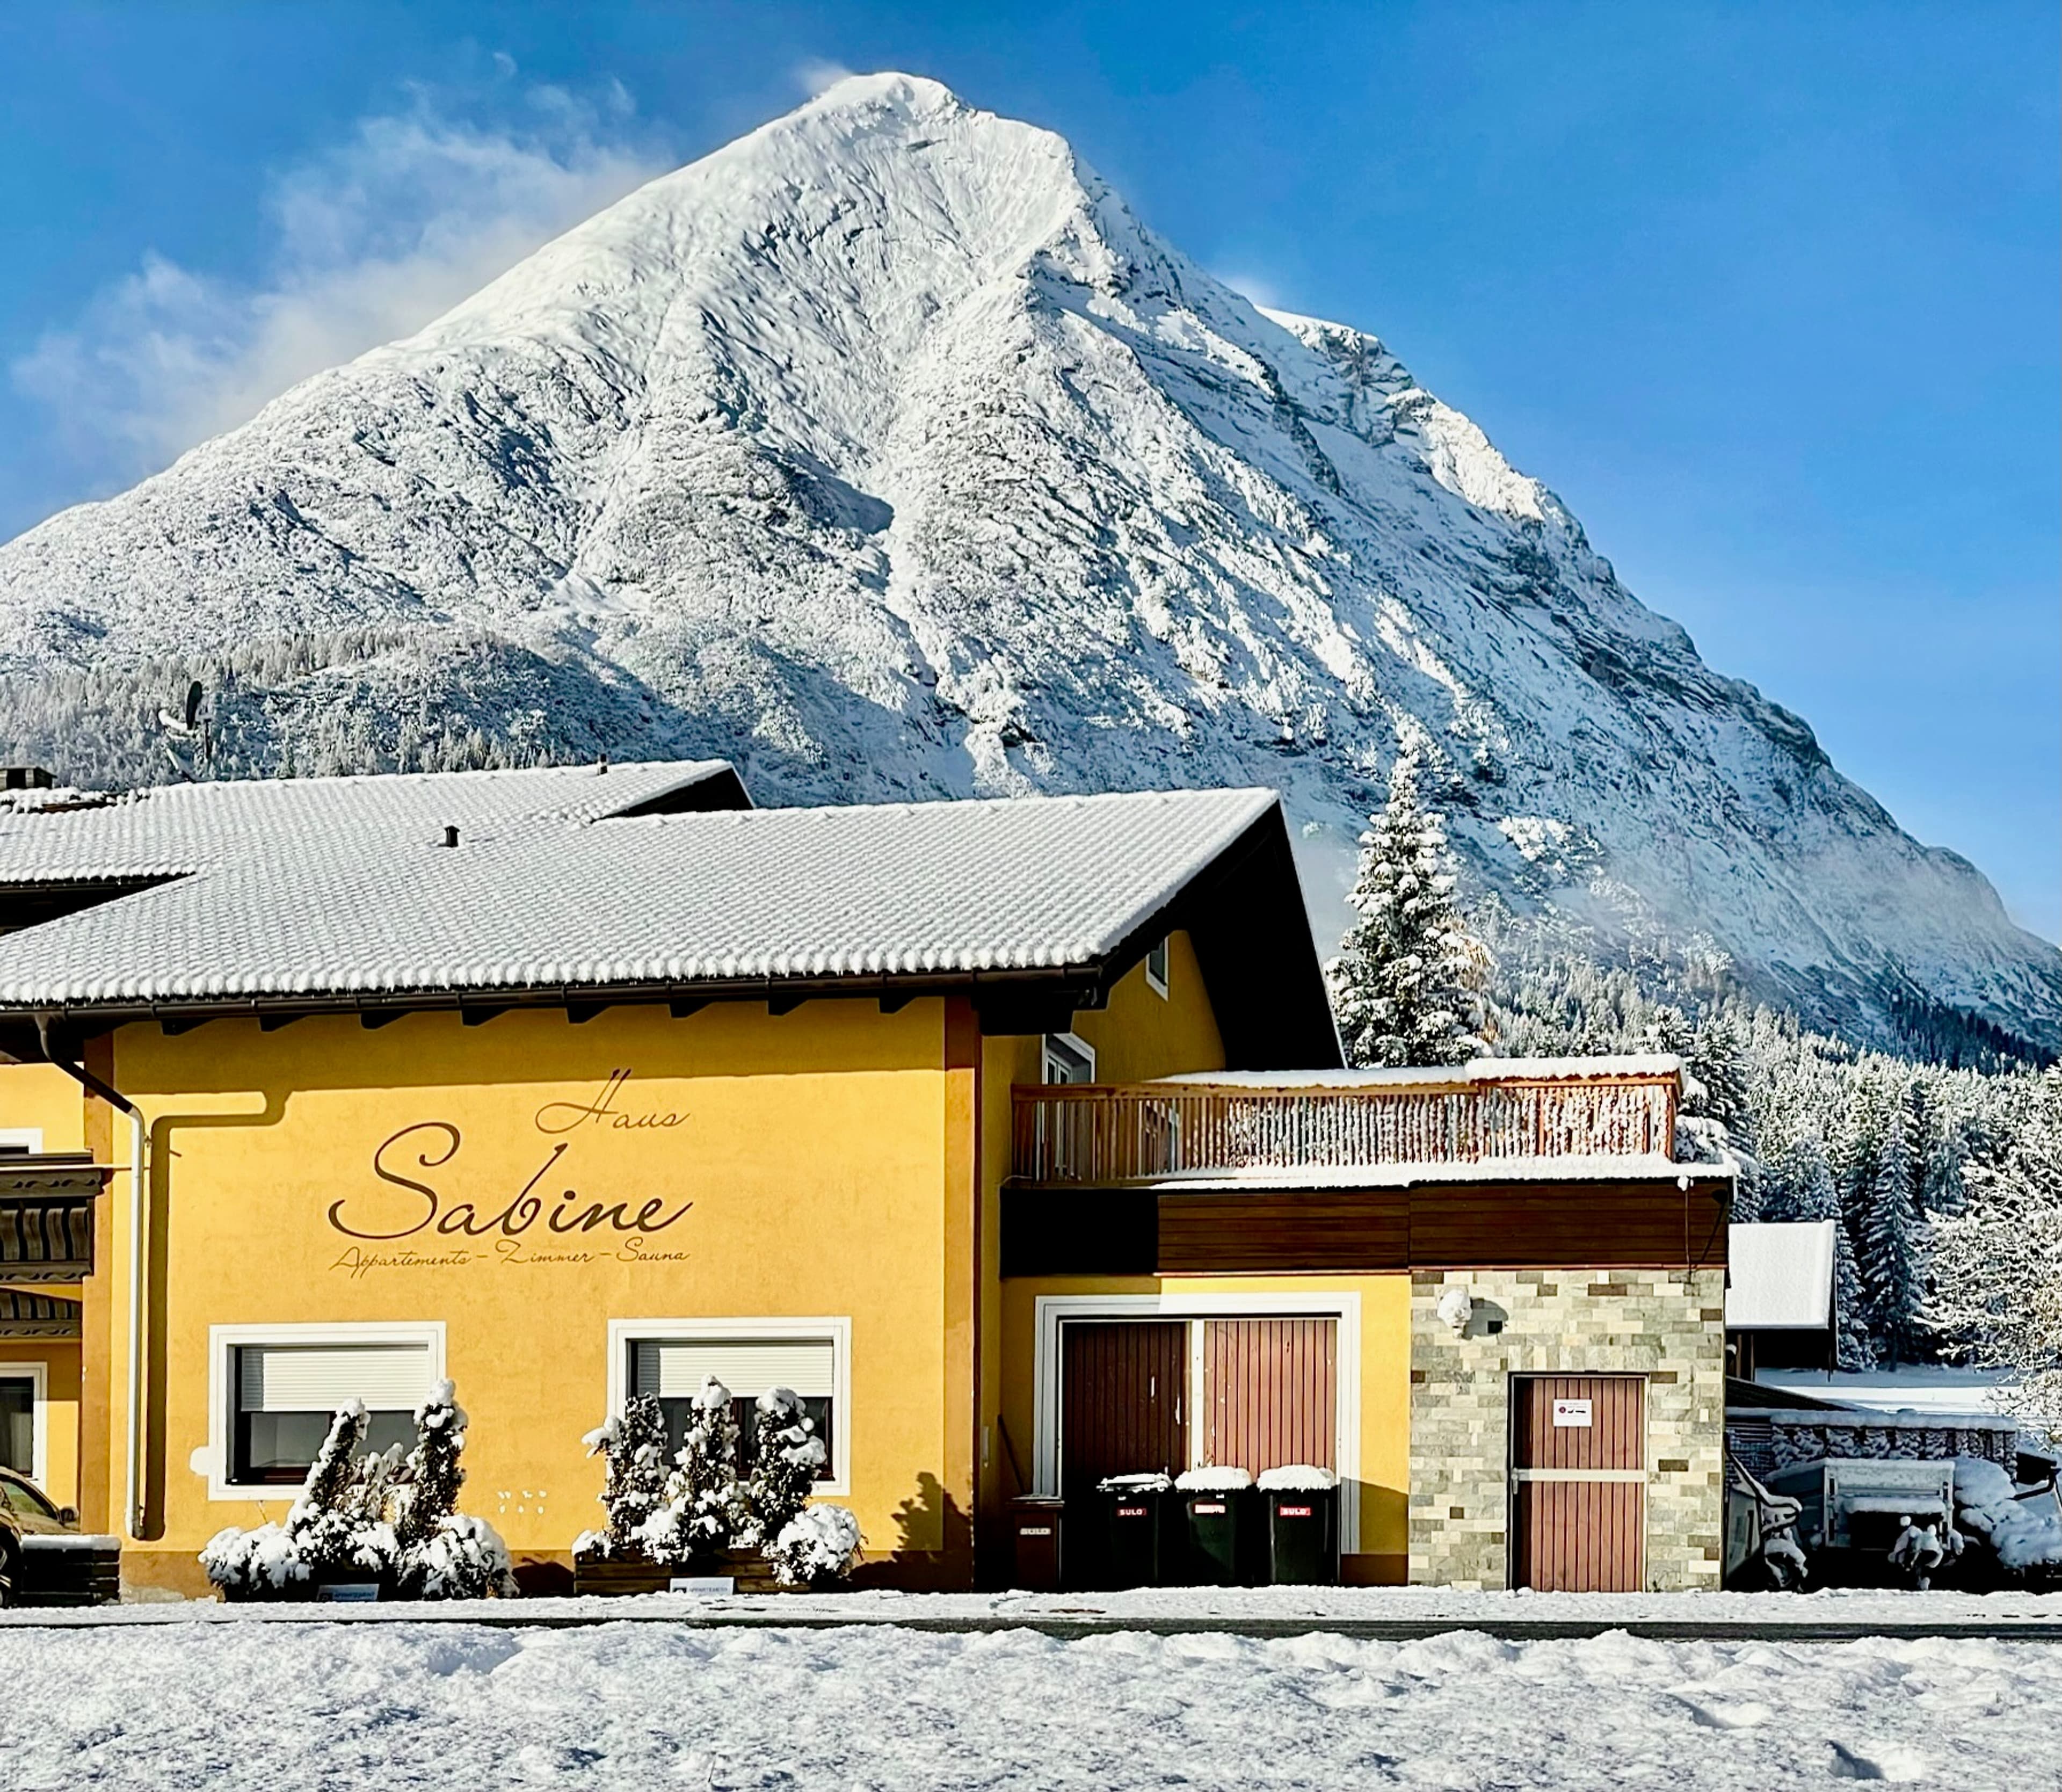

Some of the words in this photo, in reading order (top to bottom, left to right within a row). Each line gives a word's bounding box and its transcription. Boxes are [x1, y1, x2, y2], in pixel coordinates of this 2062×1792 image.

[535, 1069, 691, 1134] Haus
[328, 1122, 694, 1239] Sabine
[329, 1247, 473, 1279] Appartements
[495, 1239, 594, 1264] Zimmer
[615, 1237, 691, 1263] Sauna
